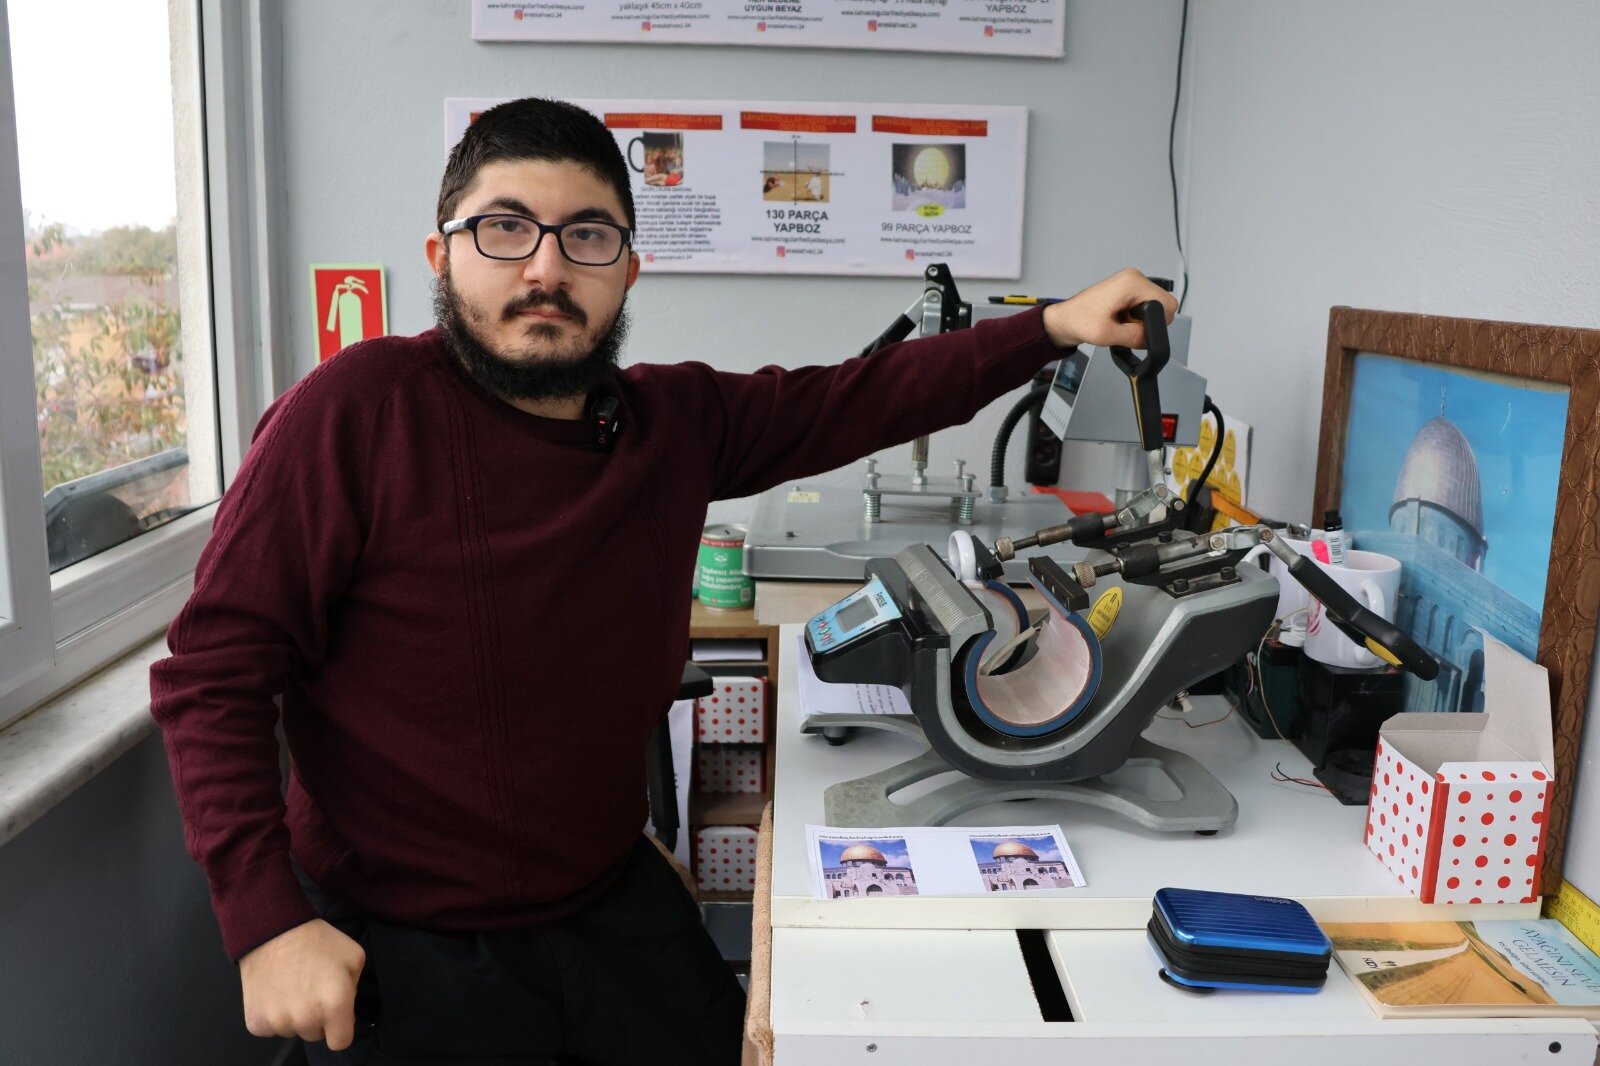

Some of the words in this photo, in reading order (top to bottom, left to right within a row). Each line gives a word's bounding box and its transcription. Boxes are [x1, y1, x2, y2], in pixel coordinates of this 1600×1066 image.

[775, 5, 802, 13] BEYAZ
[986, 5, 1027, 13] YAPBOZ
[766, 209, 785, 220] 130
[788, 210, 829, 222] PARÇA
[774, 222, 821, 234] YAPBOZ
[881, 222, 892, 232] 99
[895, 223, 930, 234] PARÇA
[932, 224, 972, 234] YAPBOZ
